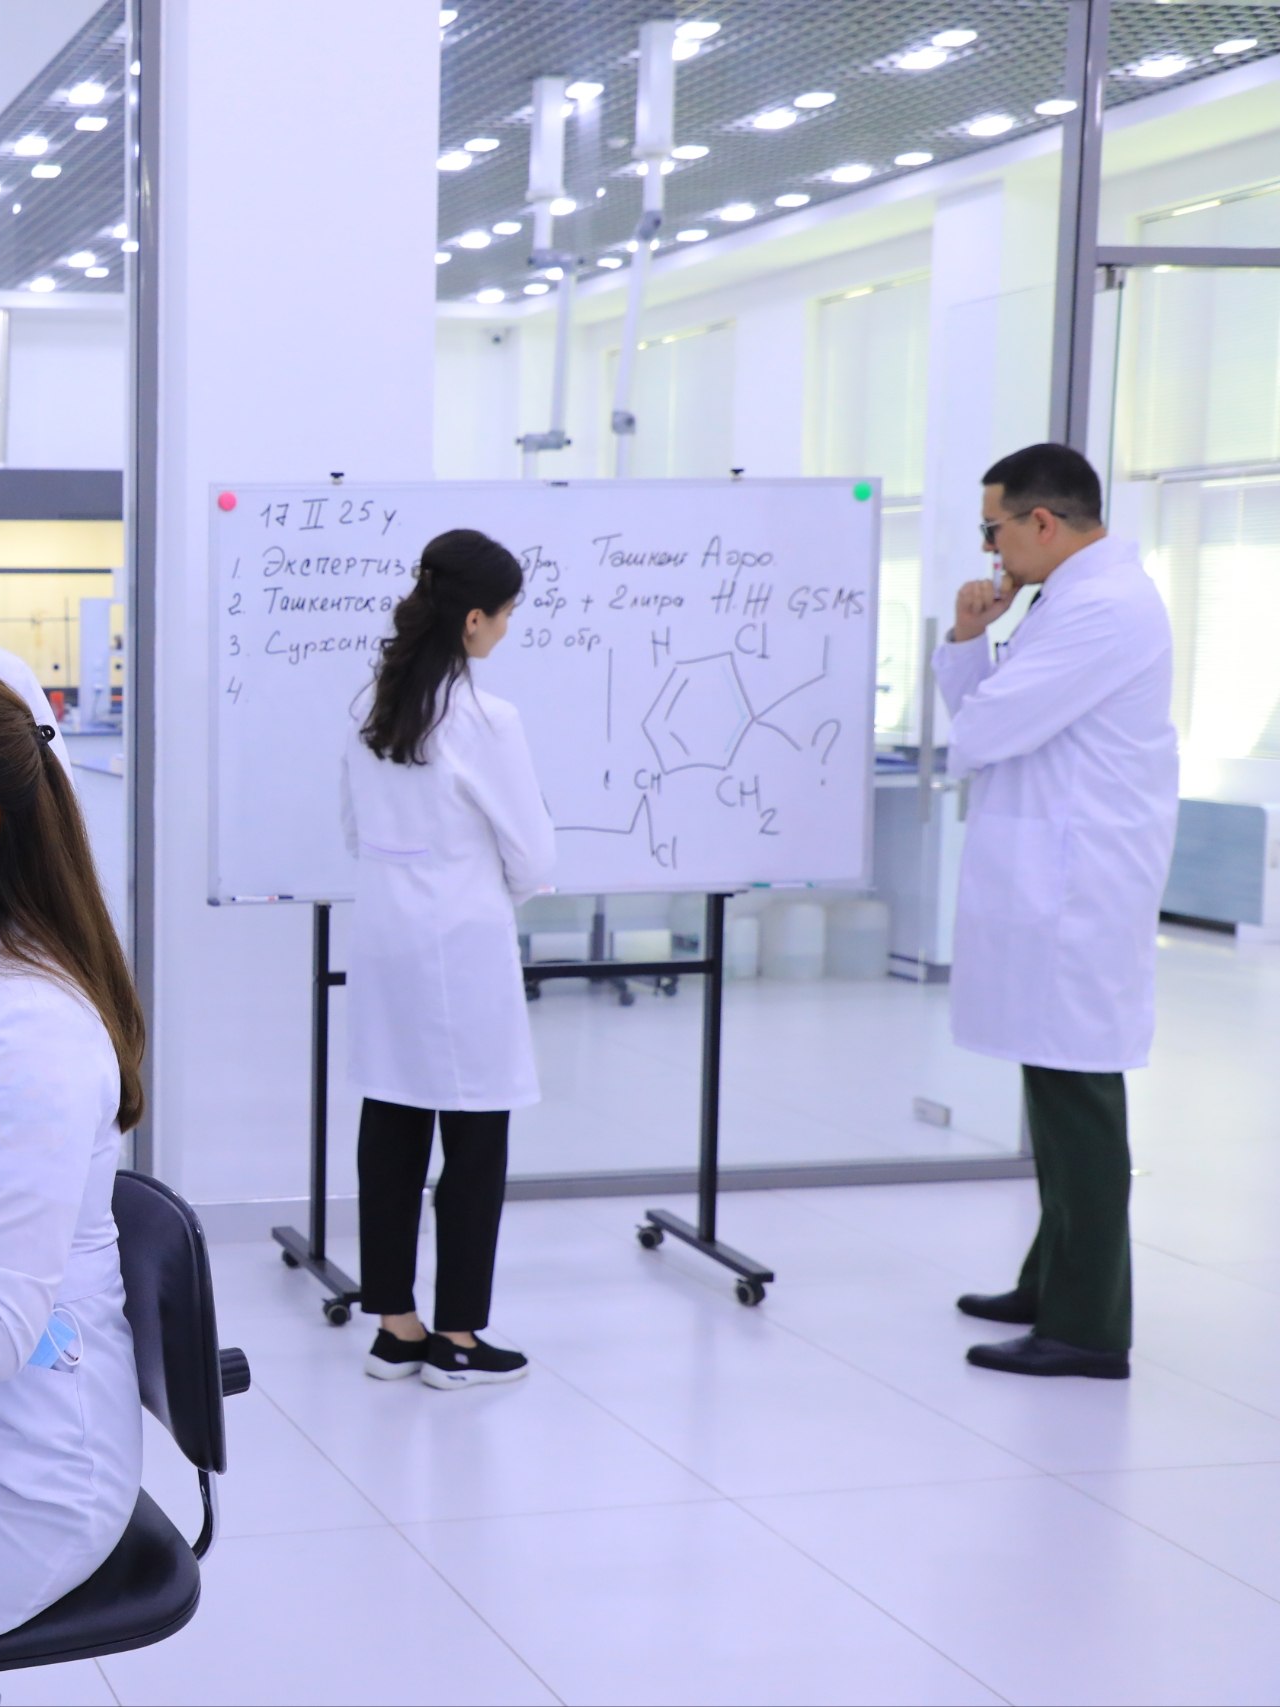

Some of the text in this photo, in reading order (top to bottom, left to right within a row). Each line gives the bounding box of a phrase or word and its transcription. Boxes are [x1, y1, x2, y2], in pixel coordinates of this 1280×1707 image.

[260, 503, 289, 528] 17
[339, 500, 374, 524] 25
[263, 587, 404, 615] Ташкентска
[521, 628, 551, 648] 30
[652, 626, 670, 667] H
